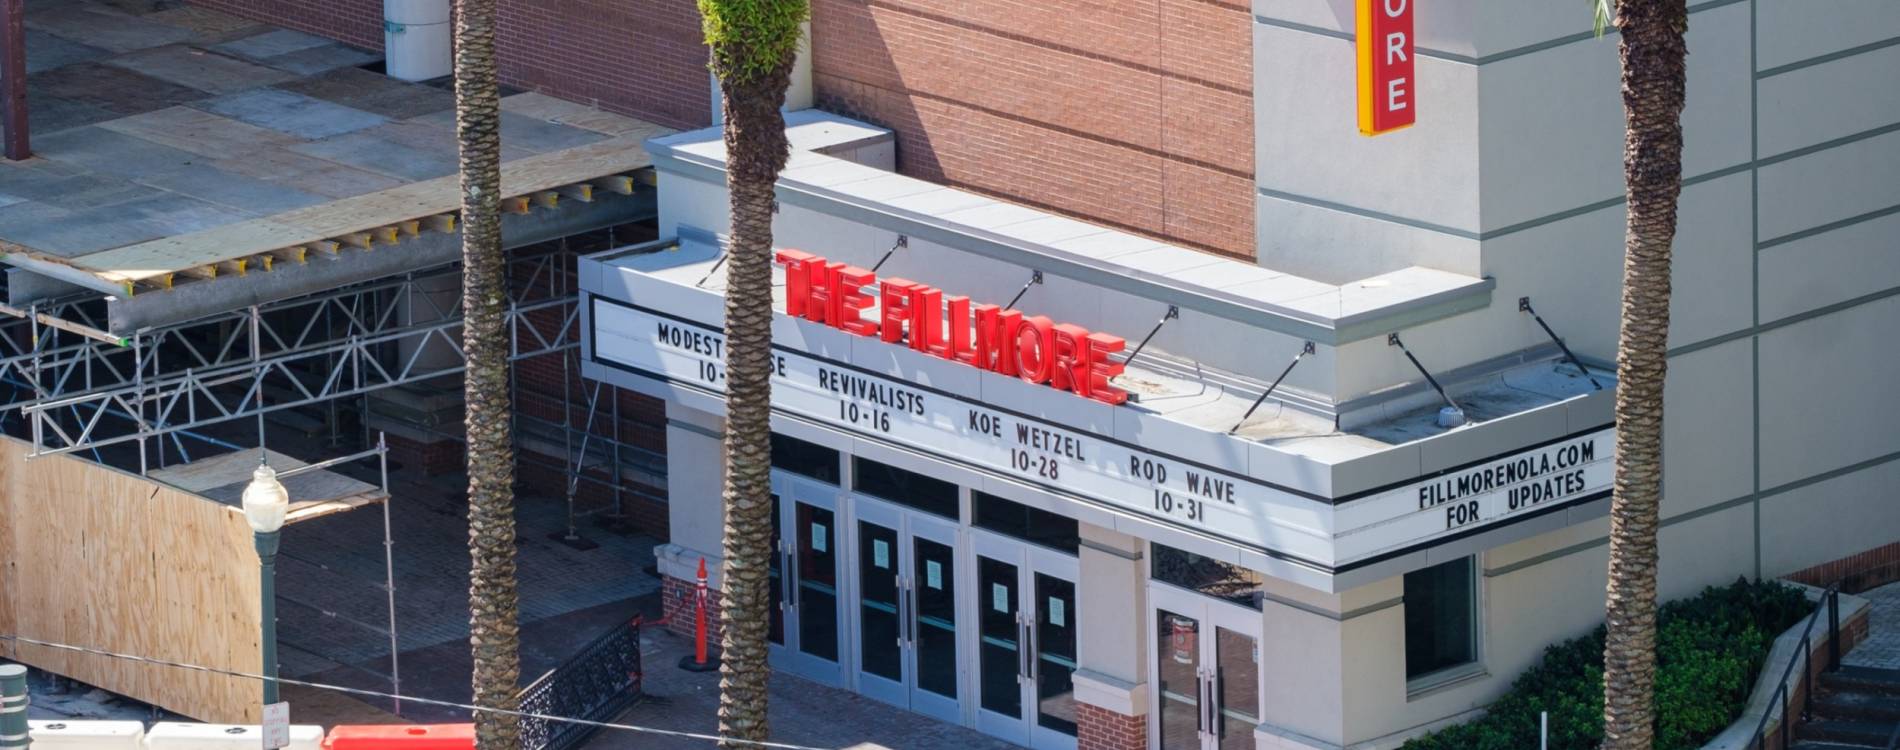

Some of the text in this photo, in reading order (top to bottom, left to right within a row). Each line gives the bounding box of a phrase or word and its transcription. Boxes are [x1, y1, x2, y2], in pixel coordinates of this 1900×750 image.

[658, 322, 722, 358] MODEST
[776, 249, 1130, 406] THE FILLMORE
[699, 360, 725, 382] 10-
[819, 367, 925, 416] REVIVALISTS
[841, 399, 890, 432] 10-16
[969, 409, 1085, 461] KOE WETZEL
[1011, 447, 1058, 480] 10-28
[1131, 455, 1235, 504] ROD WAVE
[1419, 440, 1594, 509] FILLMORENOLA.COM
[1155, 489, 1203, 522] 10-31
[1447, 469, 1585, 529] FOR UPDATES
